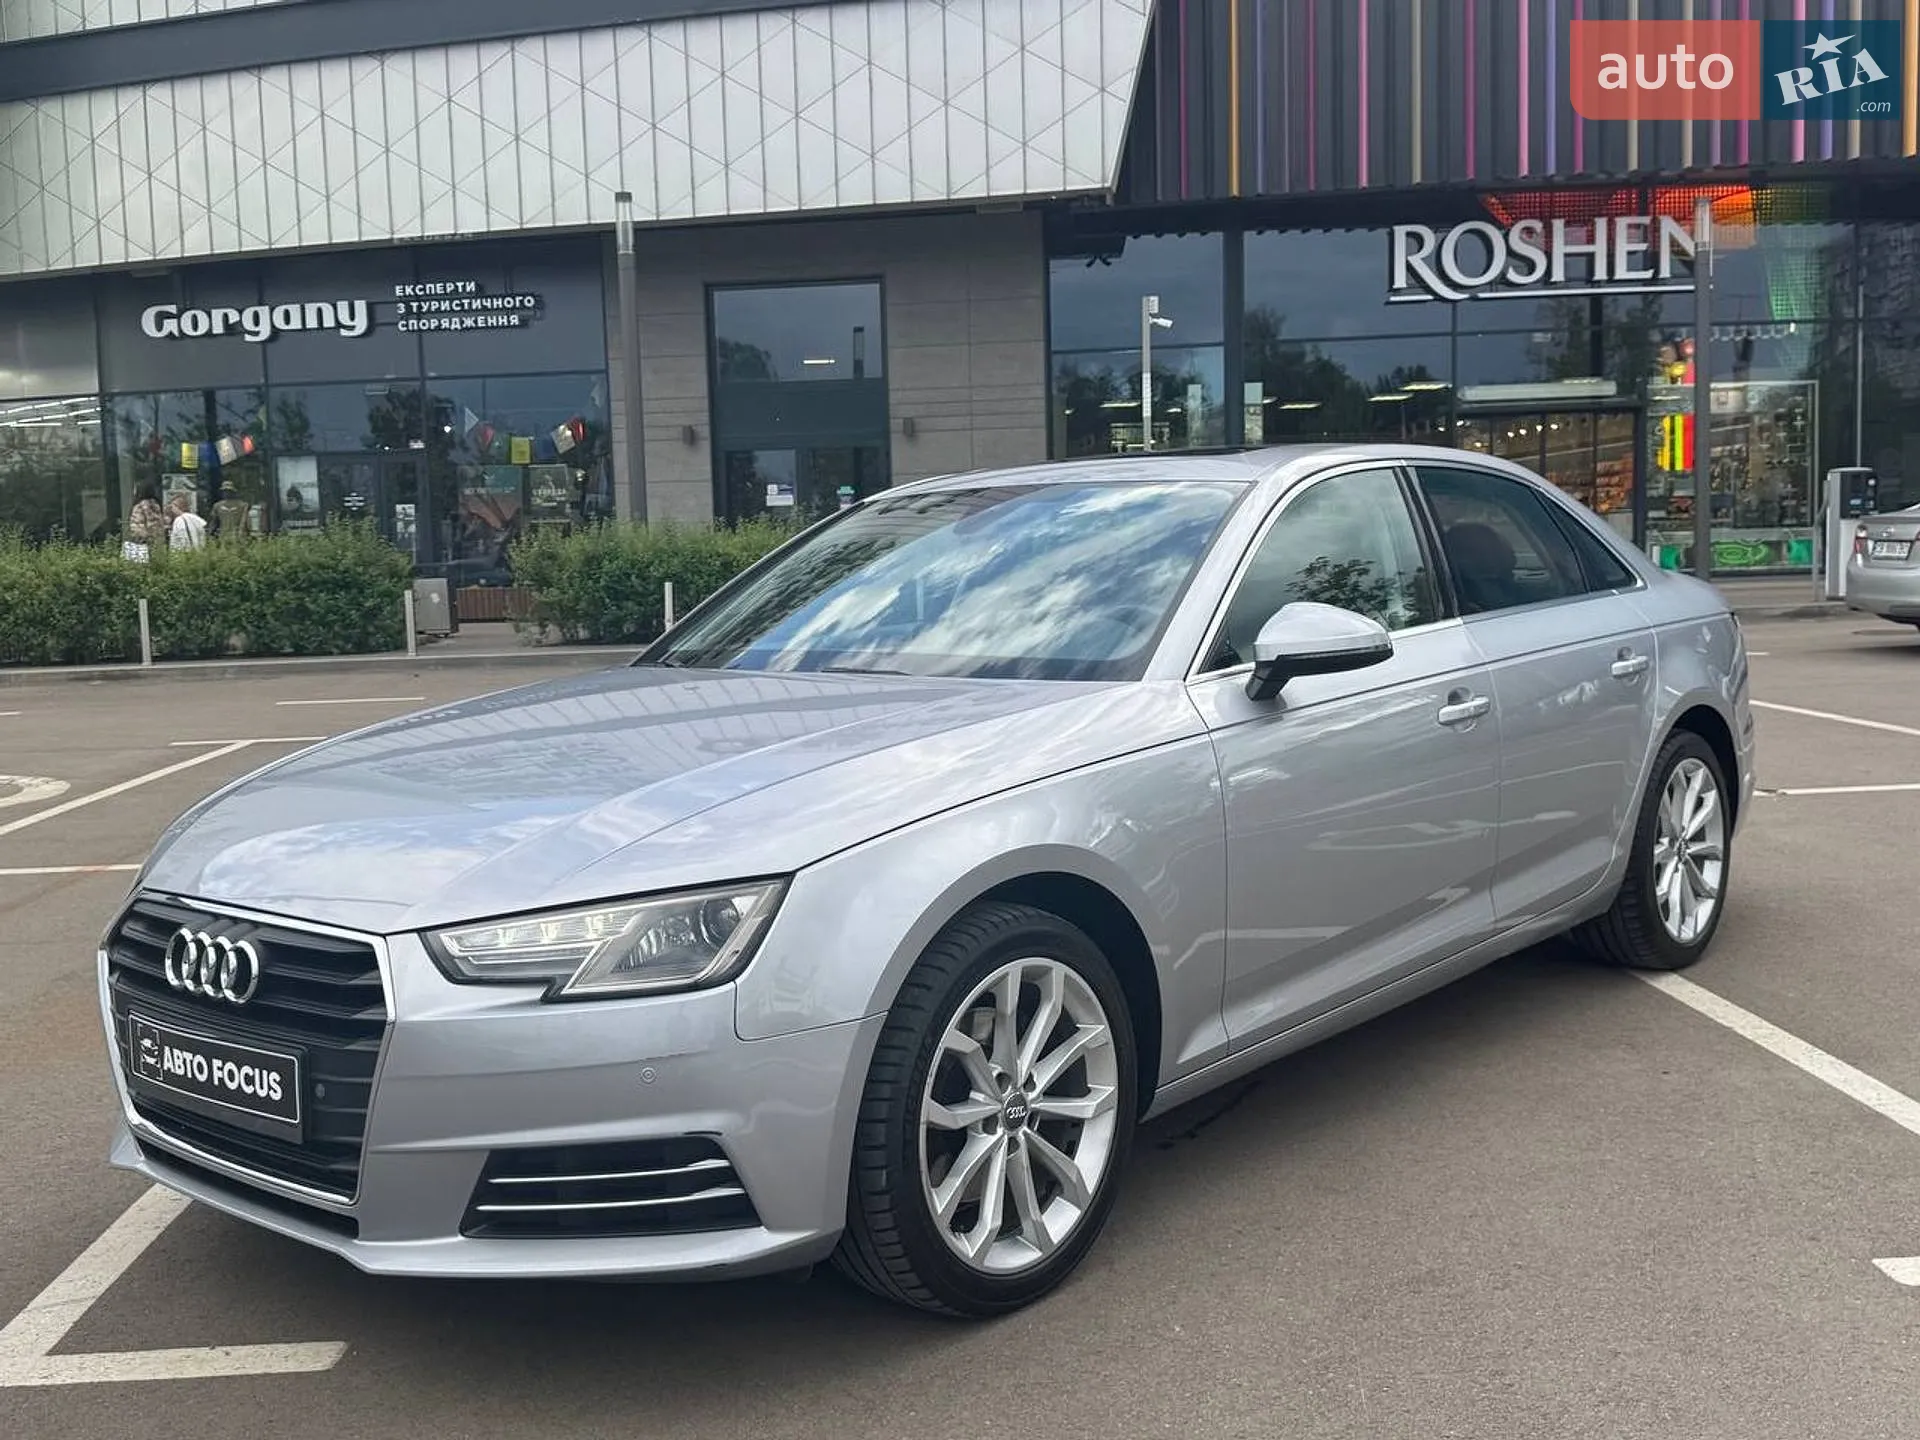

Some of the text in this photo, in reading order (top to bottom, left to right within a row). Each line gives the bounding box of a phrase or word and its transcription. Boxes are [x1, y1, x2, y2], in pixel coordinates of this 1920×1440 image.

[1391, 215, 1697, 300] ROSHEN
[395, 281, 476, 297] ЕКСПЕРТИ
[410, 296, 535, 313] ТУРИСТИЧНОГО
[141, 300, 368, 342] Gorgany
[397, 315, 520, 331] СПОРЯДЖЕННЯ
[163, 1045, 283, 1101] АВТО FOCUS
